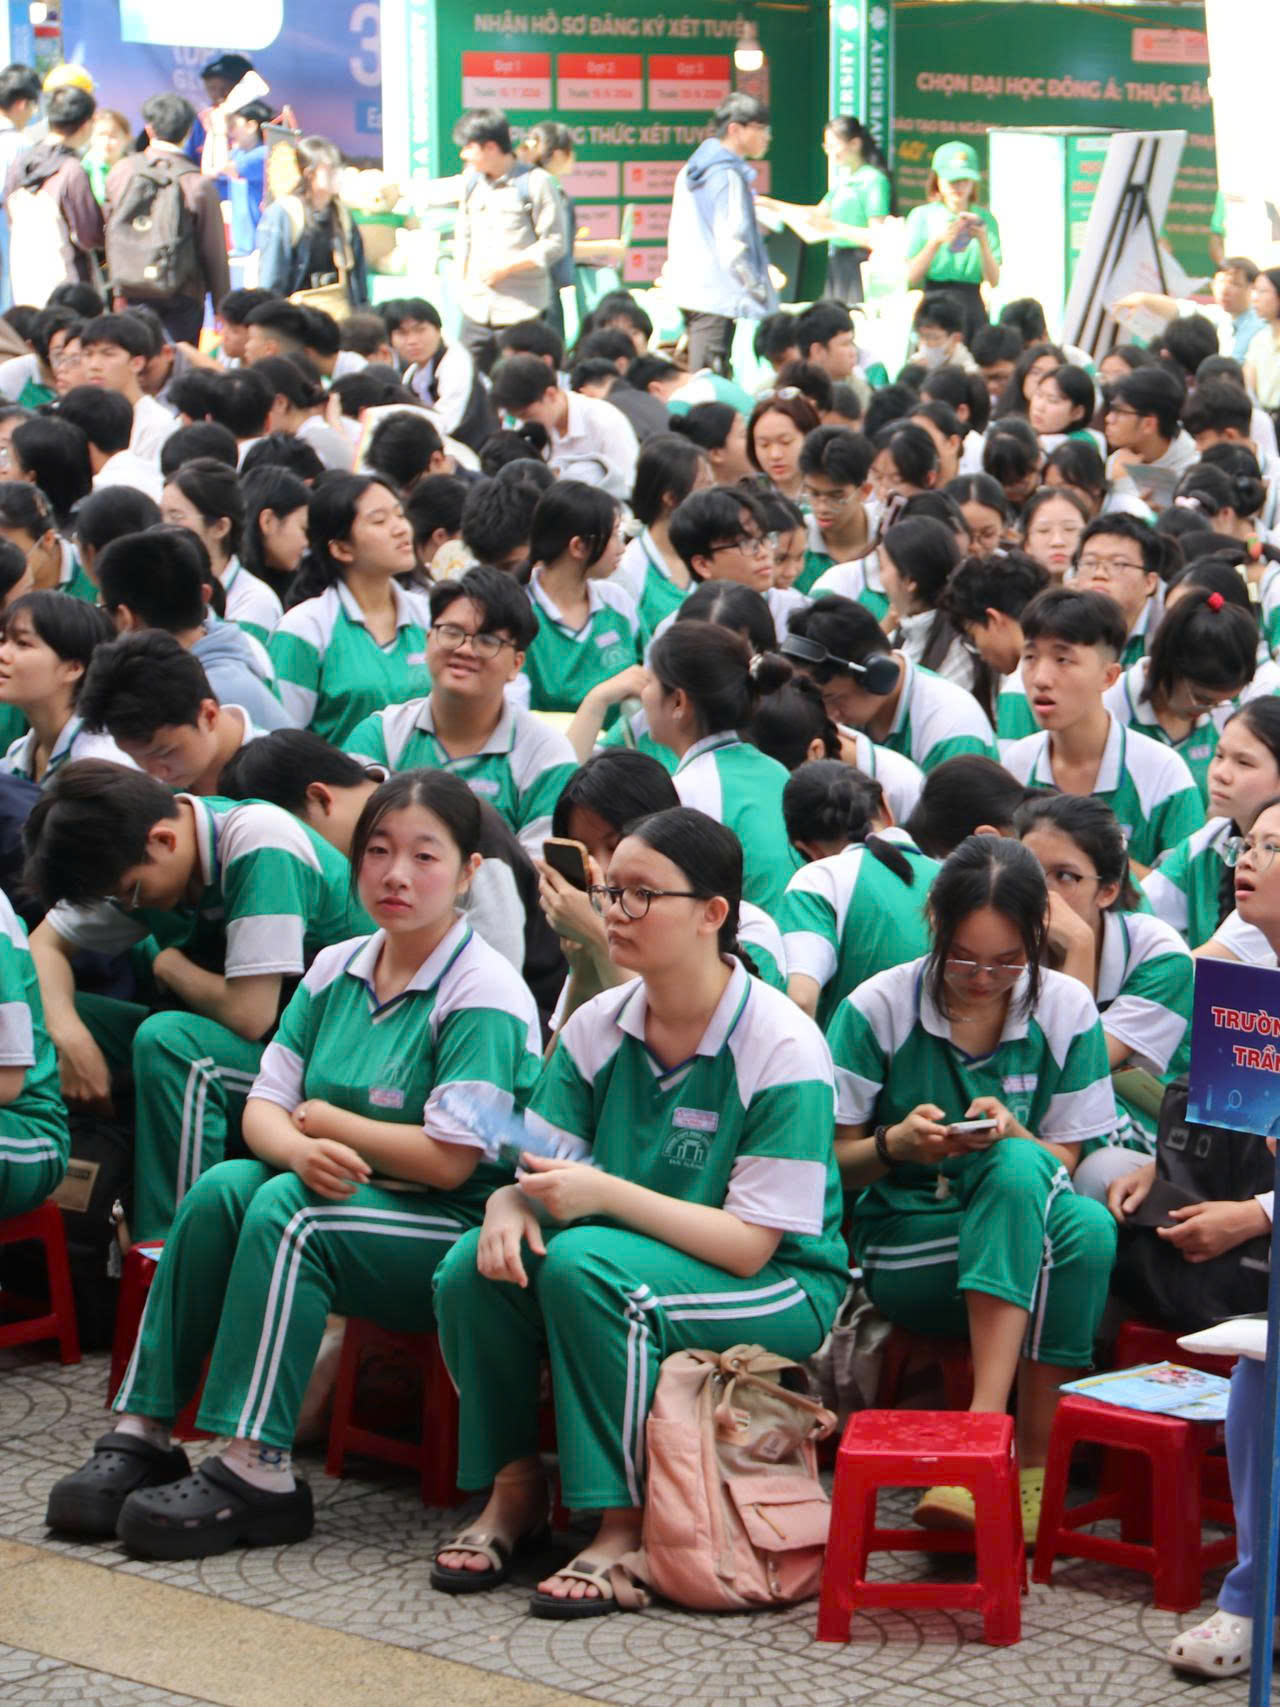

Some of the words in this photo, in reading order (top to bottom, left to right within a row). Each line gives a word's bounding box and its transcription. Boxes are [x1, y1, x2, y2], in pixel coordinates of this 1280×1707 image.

[474, 9, 528, 38] NHẬN
[531, 8, 560, 34] HỒ
[562, 13, 587, 35] SƠ
[589, 12, 640, 35] ĐĂNG
[642, 14, 665, 37] KÝ
[668, 14, 699, 37] XÉT
[838, 37, 855, 116] ERSITY
[916, 72, 969, 97] CHỌN
[971, 74, 1003, 100] ĐẠI
[1006, 76, 1044, 101] HỌC
[1047, 75, 1101, 100] ĐÔNG
[1125, 81, 1177, 110] THỰC
[589, 121, 636, 145] THỨC
[640, 122, 669, 145] XÉT
